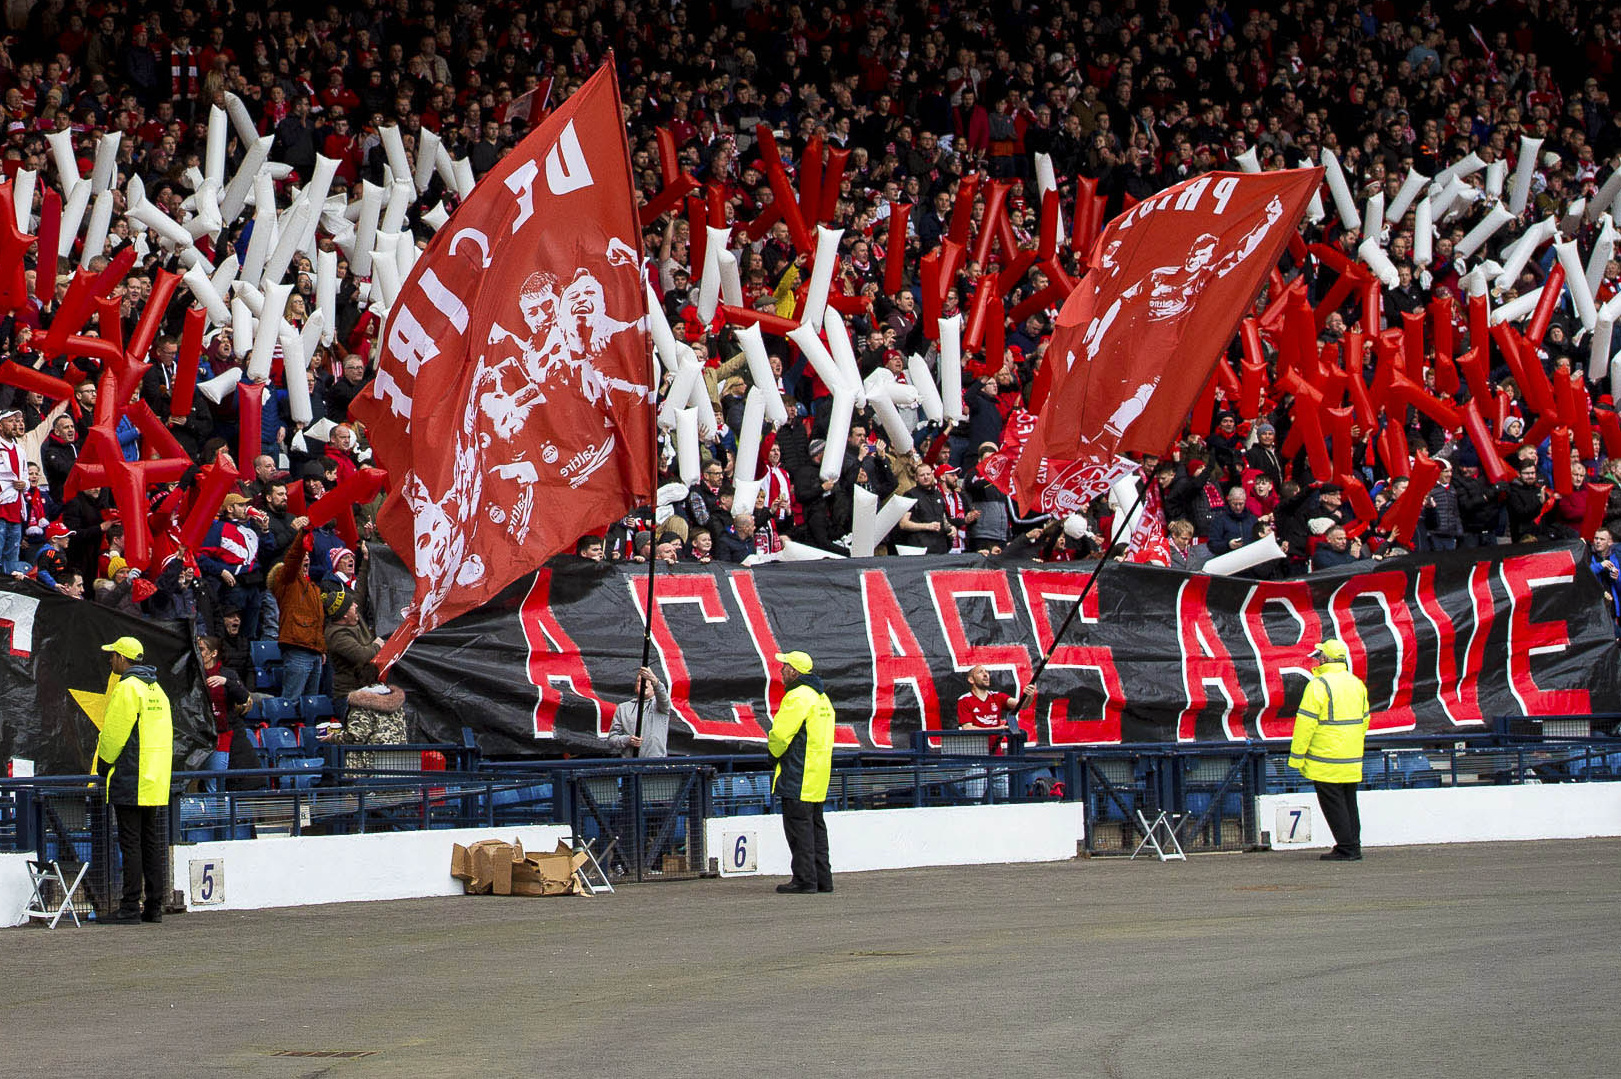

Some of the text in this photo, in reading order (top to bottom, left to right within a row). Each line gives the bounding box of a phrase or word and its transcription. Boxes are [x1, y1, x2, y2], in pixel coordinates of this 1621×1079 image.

[519, 549, 1592, 748] A CLASS ABOVE
[1288, 809, 1302, 840] 7
[733, 834, 748, 868] 6
[200, 862, 214, 901] 5
